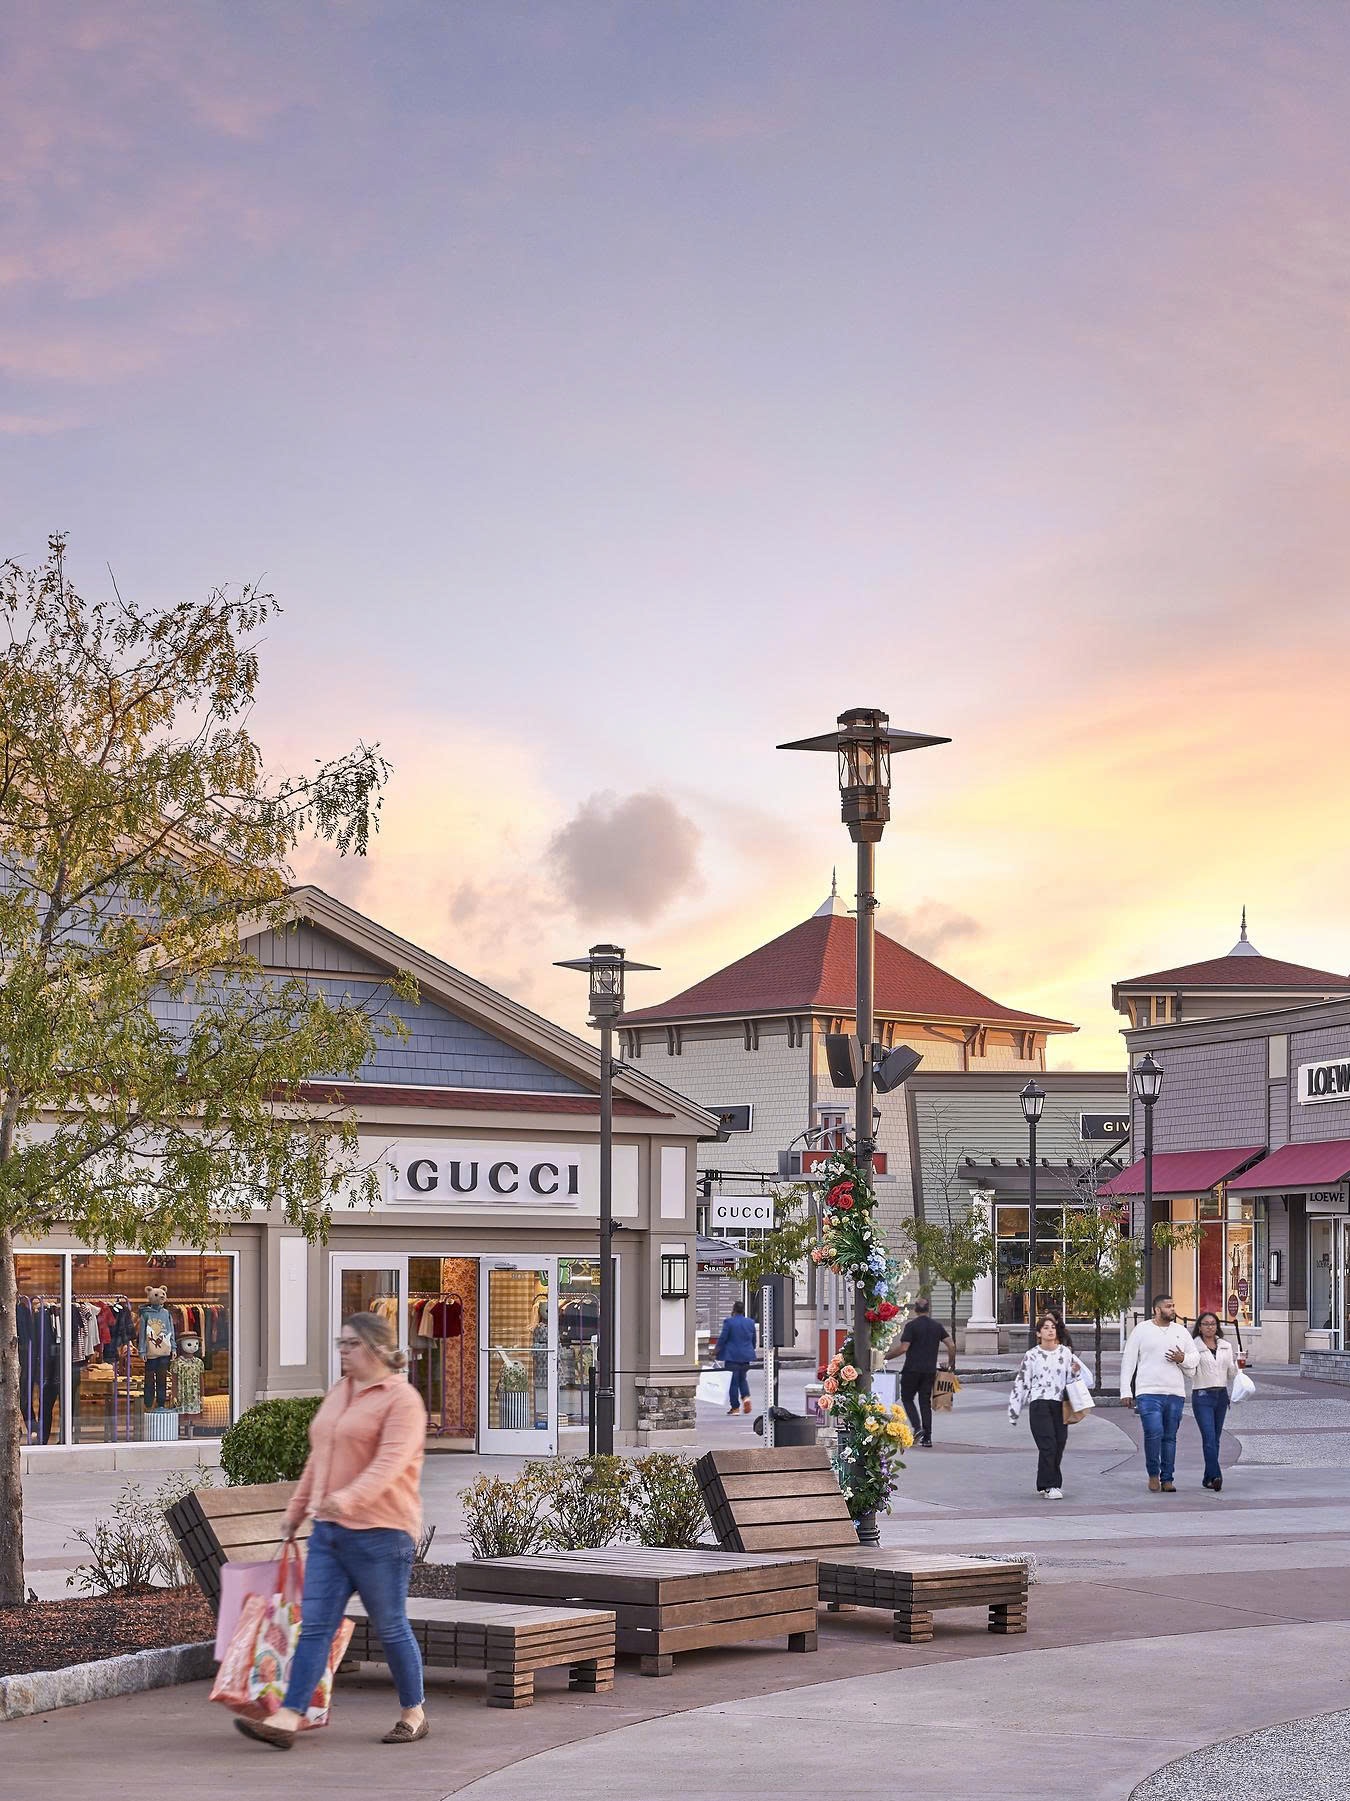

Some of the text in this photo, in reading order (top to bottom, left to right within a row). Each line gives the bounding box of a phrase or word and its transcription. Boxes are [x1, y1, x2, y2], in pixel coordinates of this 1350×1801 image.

[406, 1159, 579, 1195] GUCCI
[1310, 1191, 1345, 1203] LOEWE
[717, 1206, 770, 1219] GUCCI
